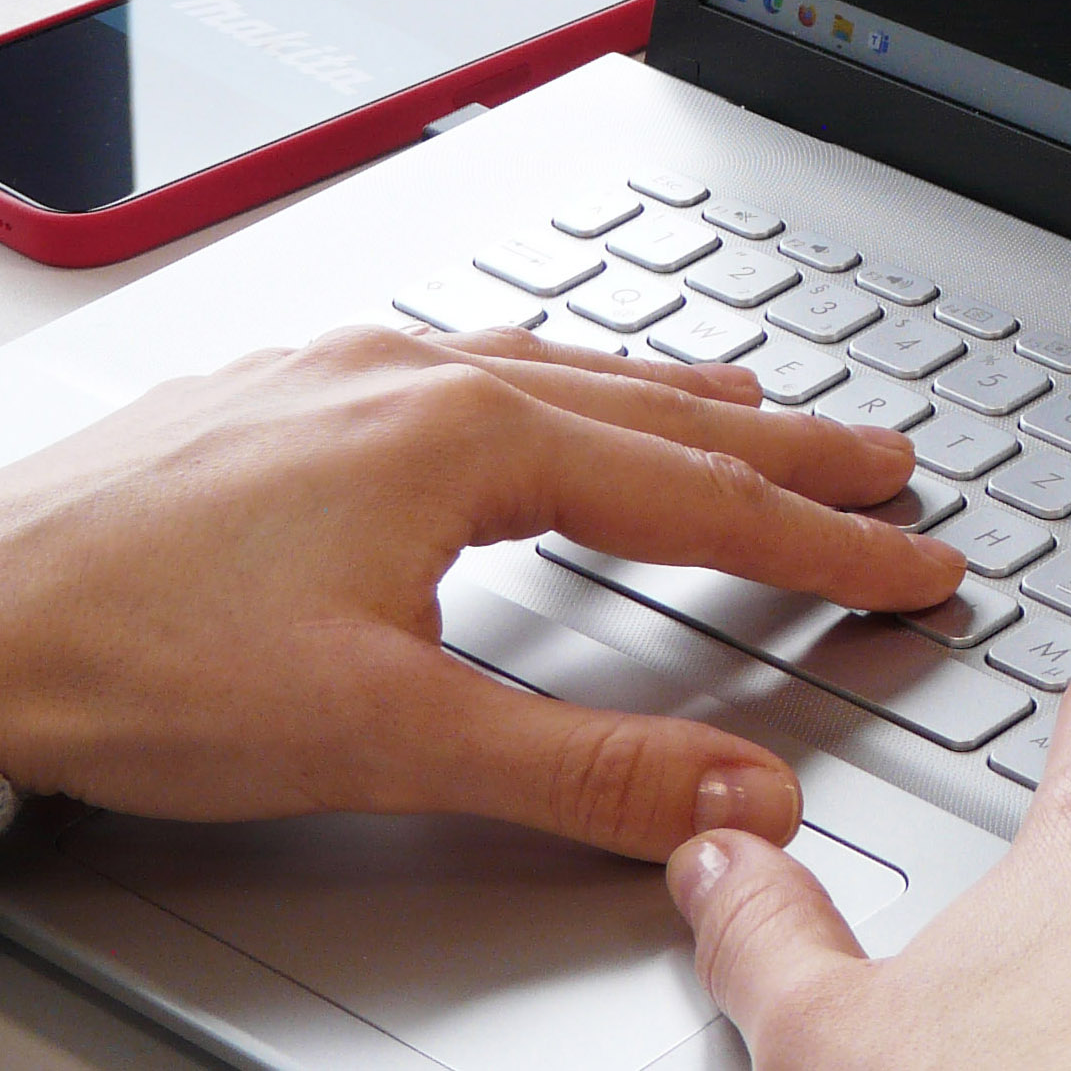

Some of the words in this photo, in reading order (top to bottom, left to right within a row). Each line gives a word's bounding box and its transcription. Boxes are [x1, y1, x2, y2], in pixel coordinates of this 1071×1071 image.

[727, 266, 757, 281] 2
[611, 289, 642, 306] Q
[810, 301, 838, 315] 3
[690, 321, 729, 338] W
[895, 339, 922, 352] 4
[774, 360, 804, 376] E
[977, 373, 1008, 387] 5
[858, 397, 887, 414] R
[946, 434, 975, 449] T
[1031, 472, 1065, 489] Z
[974, 528, 1011, 547] H
[1028, 640, 1070, 662] M
